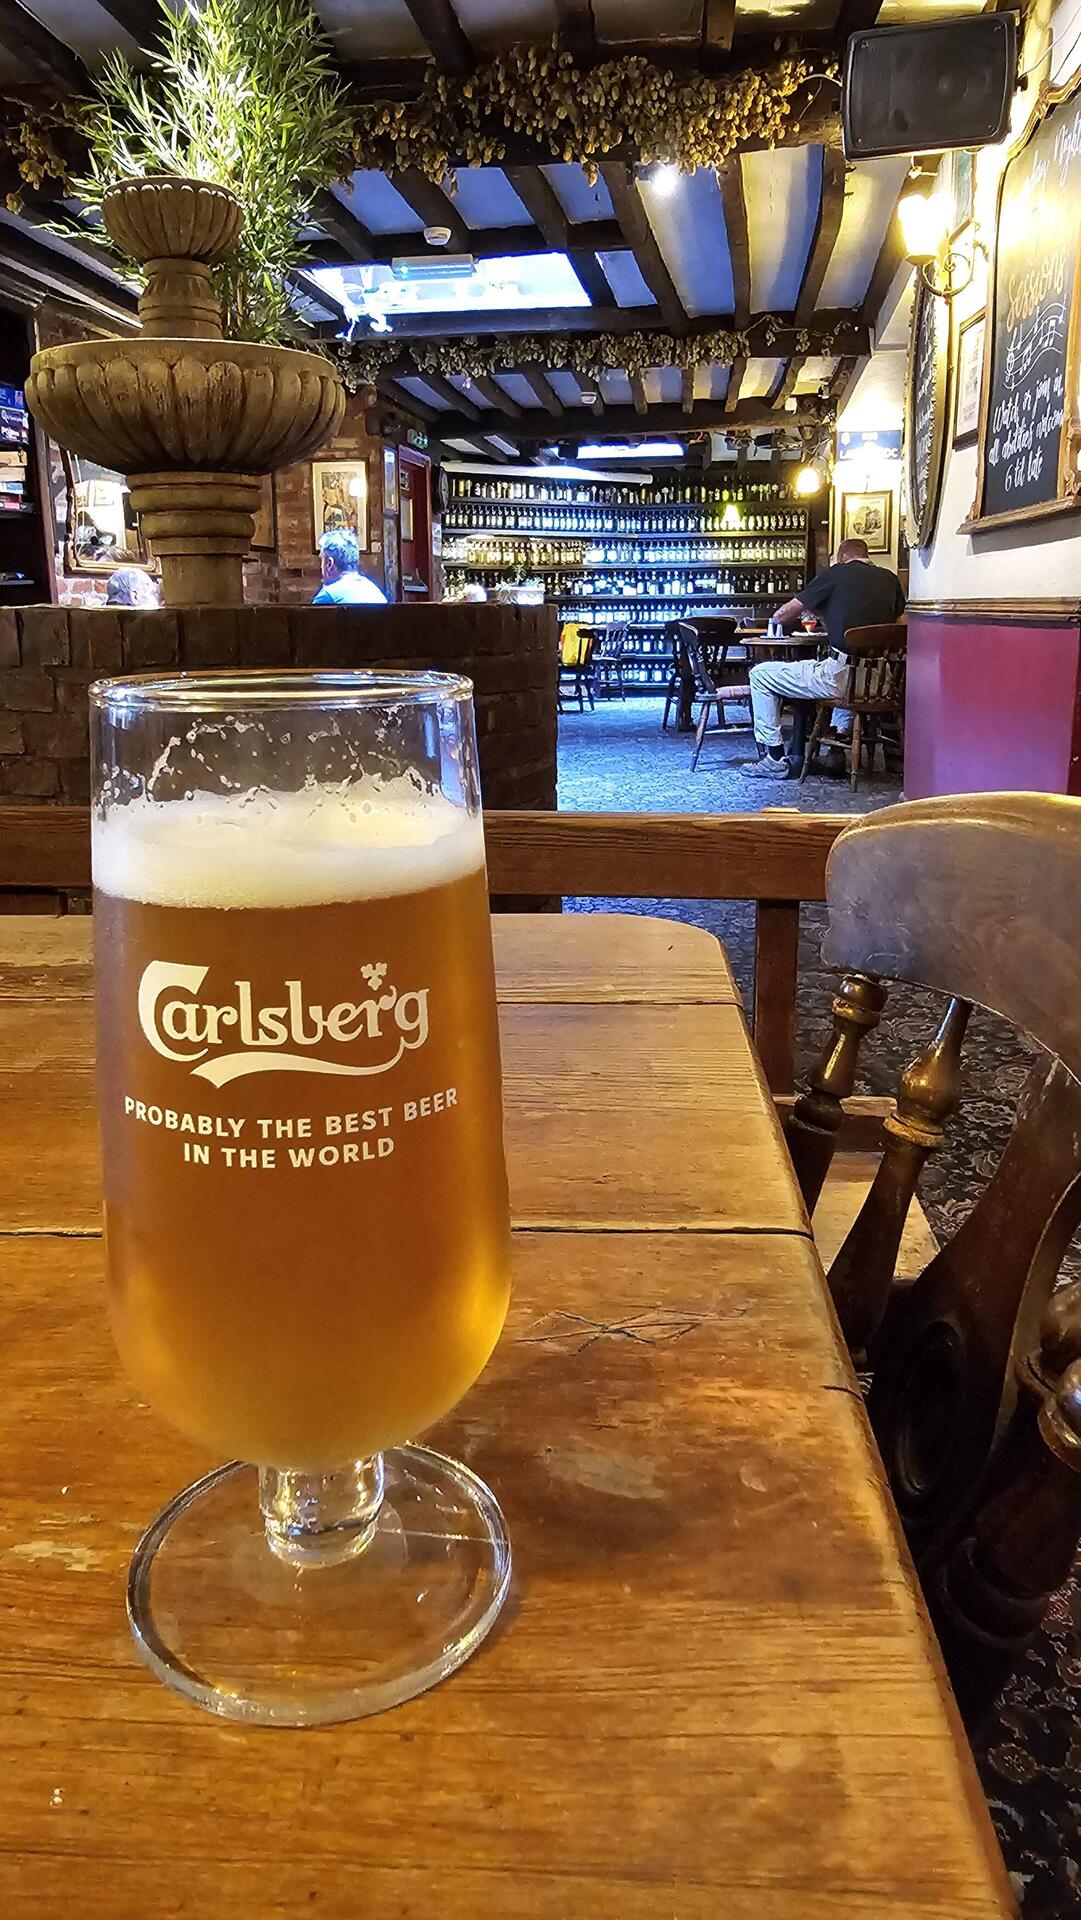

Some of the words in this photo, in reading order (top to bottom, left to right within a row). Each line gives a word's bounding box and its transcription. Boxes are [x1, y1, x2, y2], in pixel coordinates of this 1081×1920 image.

[992, 392, 1019, 434] Watch
[1004, 463, 1014, 492] 6
[1028, 445, 1043, 482] late
[138, 960, 430, 1062] Carlsberg
[124, 1095, 246, 1139] PROBABLY
[257, 1118, 313, 1140] THE
[325, 1106, 394, 1137] BEST
[403, 1087, 458, 1123] BEER
[183, 1142, 210, 1165] IN
[221, 1147, 277, 1169] THE
[288, 1137, 395, 1169] WORLD
